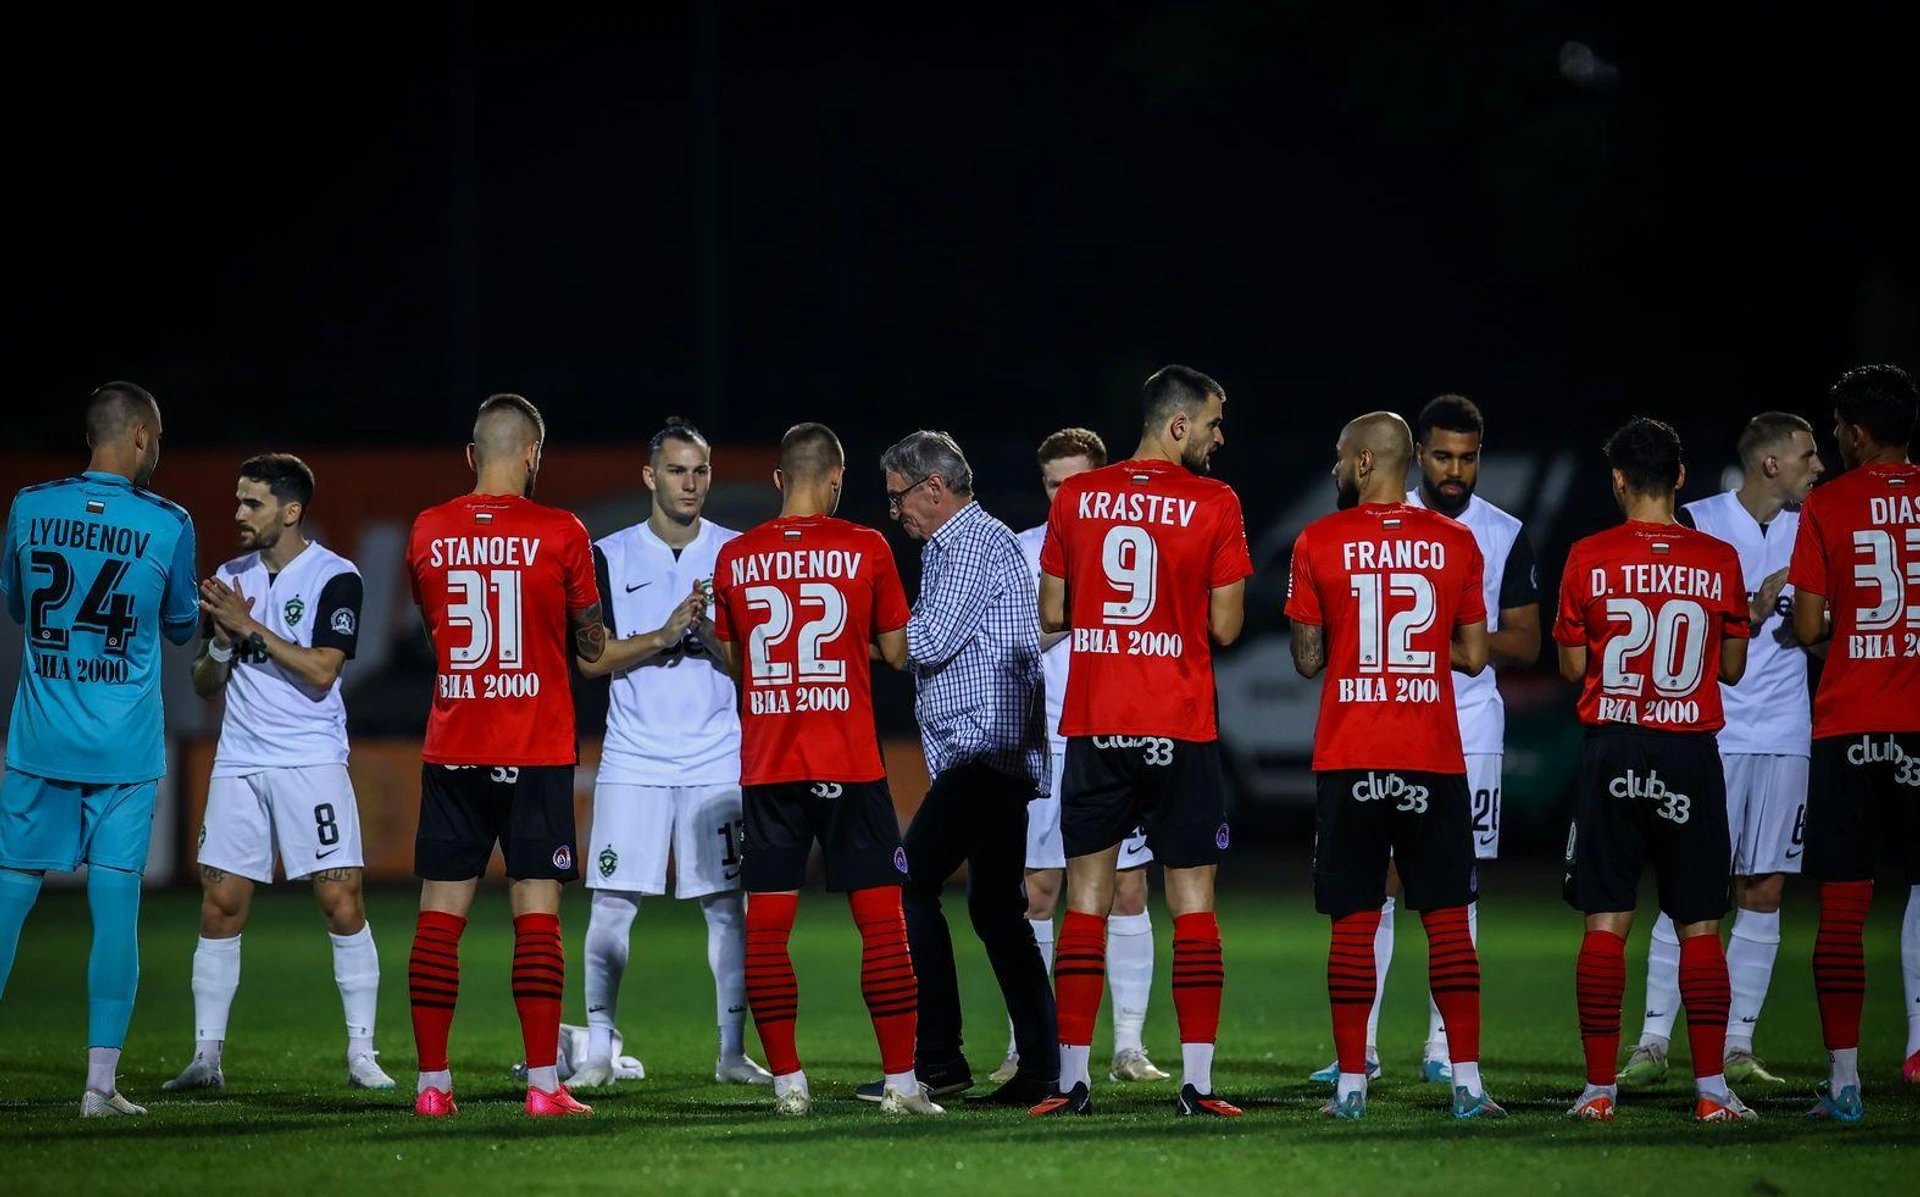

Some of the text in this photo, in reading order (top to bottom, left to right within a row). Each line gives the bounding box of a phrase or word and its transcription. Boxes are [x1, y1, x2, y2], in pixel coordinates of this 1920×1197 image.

[1079, 491, 1197, 527] KRASTEV
[30, 518, 150, 559] LYUBENOV
[430, 536, 540, 567] STANOEV
[1343, 540, 1445, 570] FRANCO
[731, 550, 862, 587] NAYDENOV
[1102, 525, 1158, 625] 9
[1591, 564, 1722, 601] D. TEIXEIRA
[31, 551, 138, 656] 24
[447, 569, 523, 670] 31
[745, 582, 848, 686] 22
[1350, 573, 1437, 674] 12
[1128, 630, 1183, 658] 2000
[1603, 598, 1708, 698] 20
[77, 658, 129, 683] 2000
[483, 672, 540, 698] 2000
[795, 686, 850, 711] 2000
[1642, 700, 1699, 724] 2000
[314, 803, 339, 845] 8
[718, 820, 742, 865] 1
